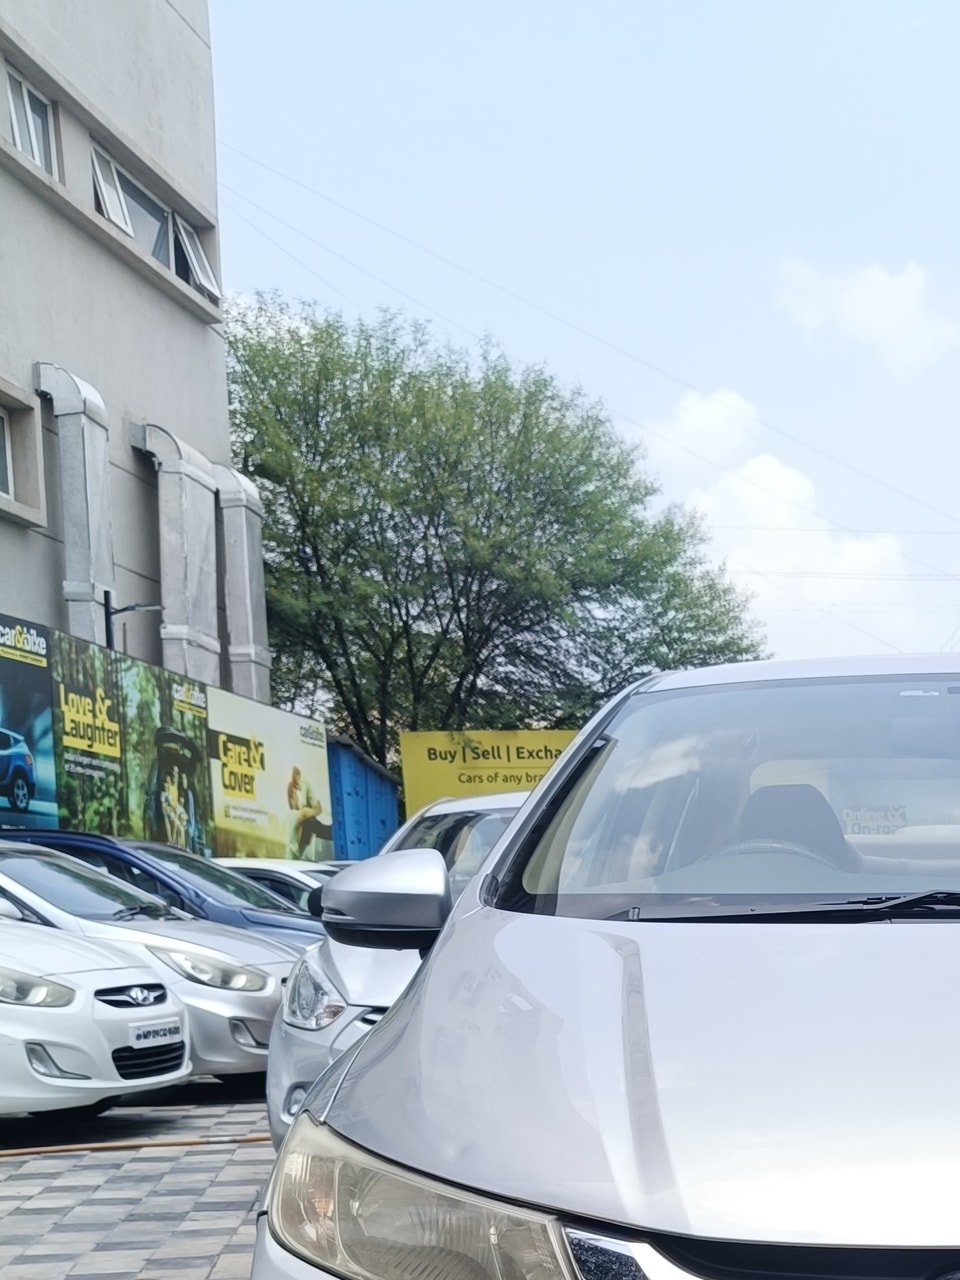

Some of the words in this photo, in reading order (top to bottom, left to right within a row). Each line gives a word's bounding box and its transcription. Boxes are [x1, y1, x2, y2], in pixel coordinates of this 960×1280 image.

[60, 683, 93, 716] Love
[96, 688, 112, 722] &
[64, 714, 119, 749] Laughter
[218, 733, 250, 768] Care
[250, 735, 265, 771] &
[427, 747, 457, 764] Buy
[472, 745, 502, 760] Sell
[222, 763, 254, 795] Cover
[458, 773, 484, 784] Cars
[487, 772, 499, 783] of
[502, 775, 525, 785] any
[843, 808, 884, 821] Online
